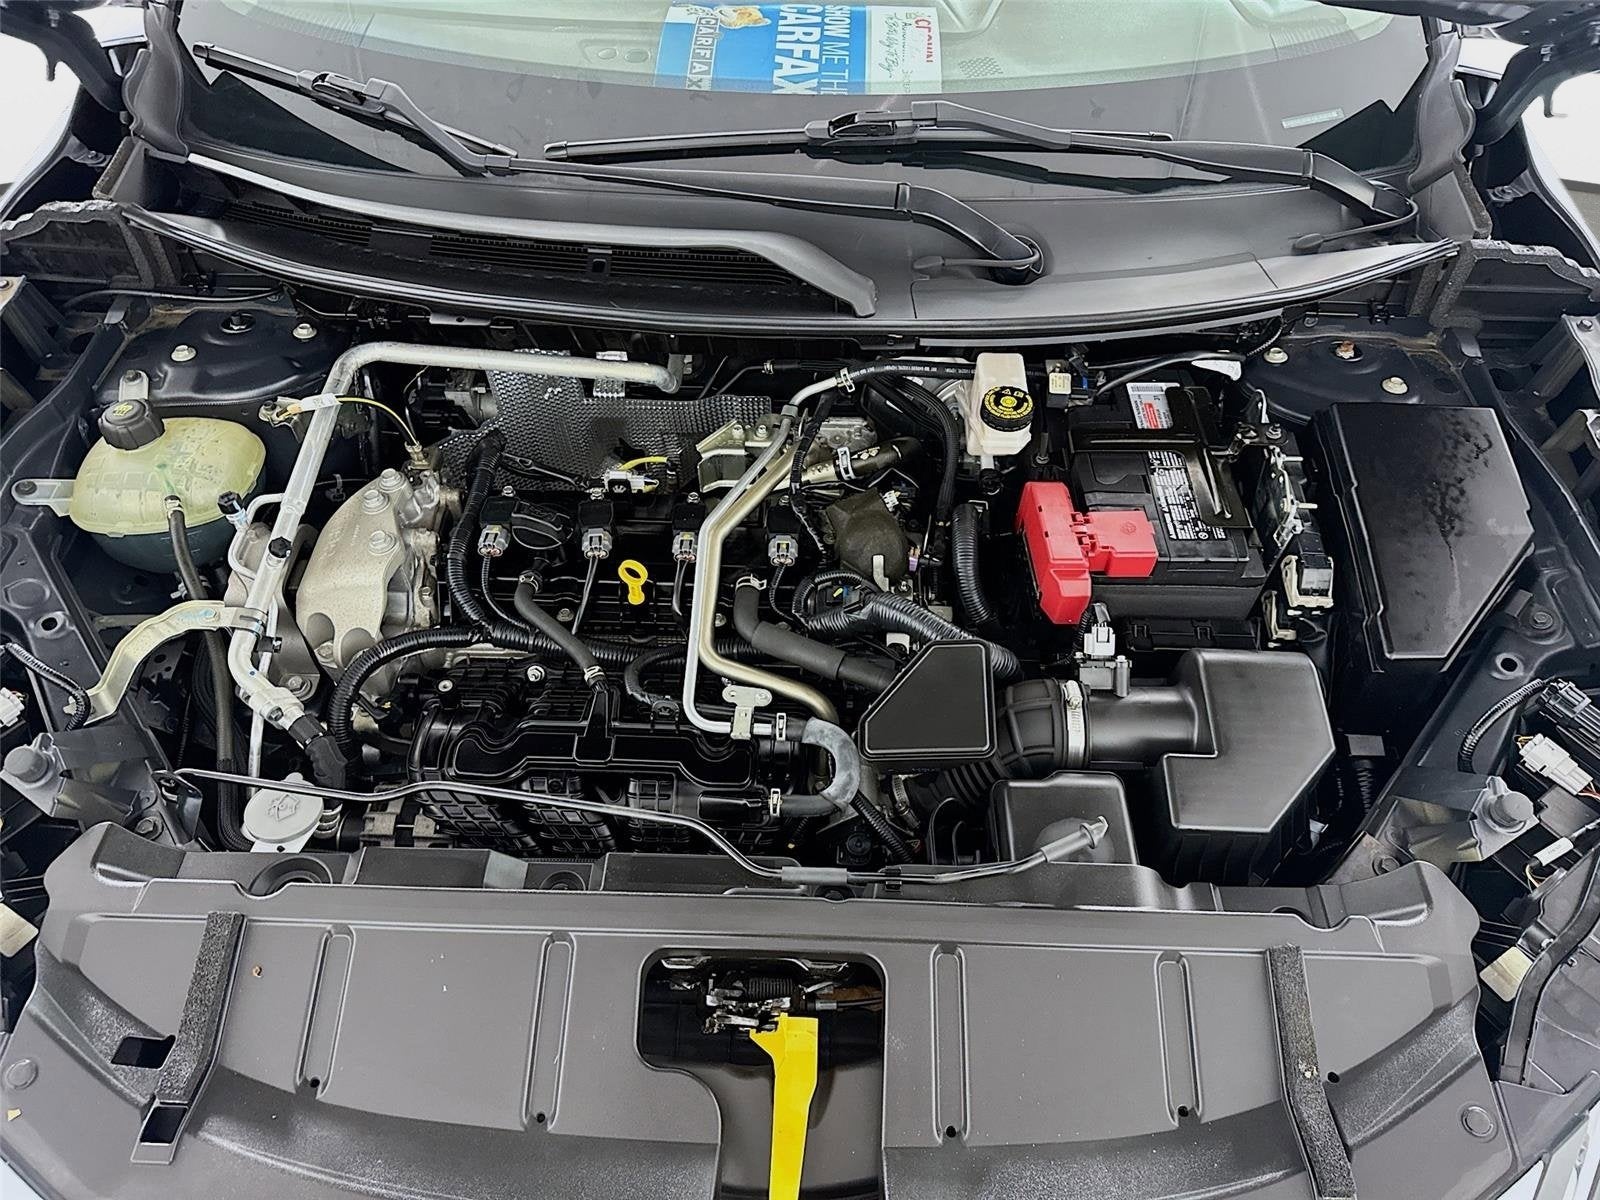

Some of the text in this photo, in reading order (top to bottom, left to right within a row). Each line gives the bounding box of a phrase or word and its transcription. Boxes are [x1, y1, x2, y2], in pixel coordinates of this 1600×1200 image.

[687, 17, 717, 90] CARFAX
[772, 3, 823, 95] CARFAX
[820, 4, 851, 96] SHOW ME THE
